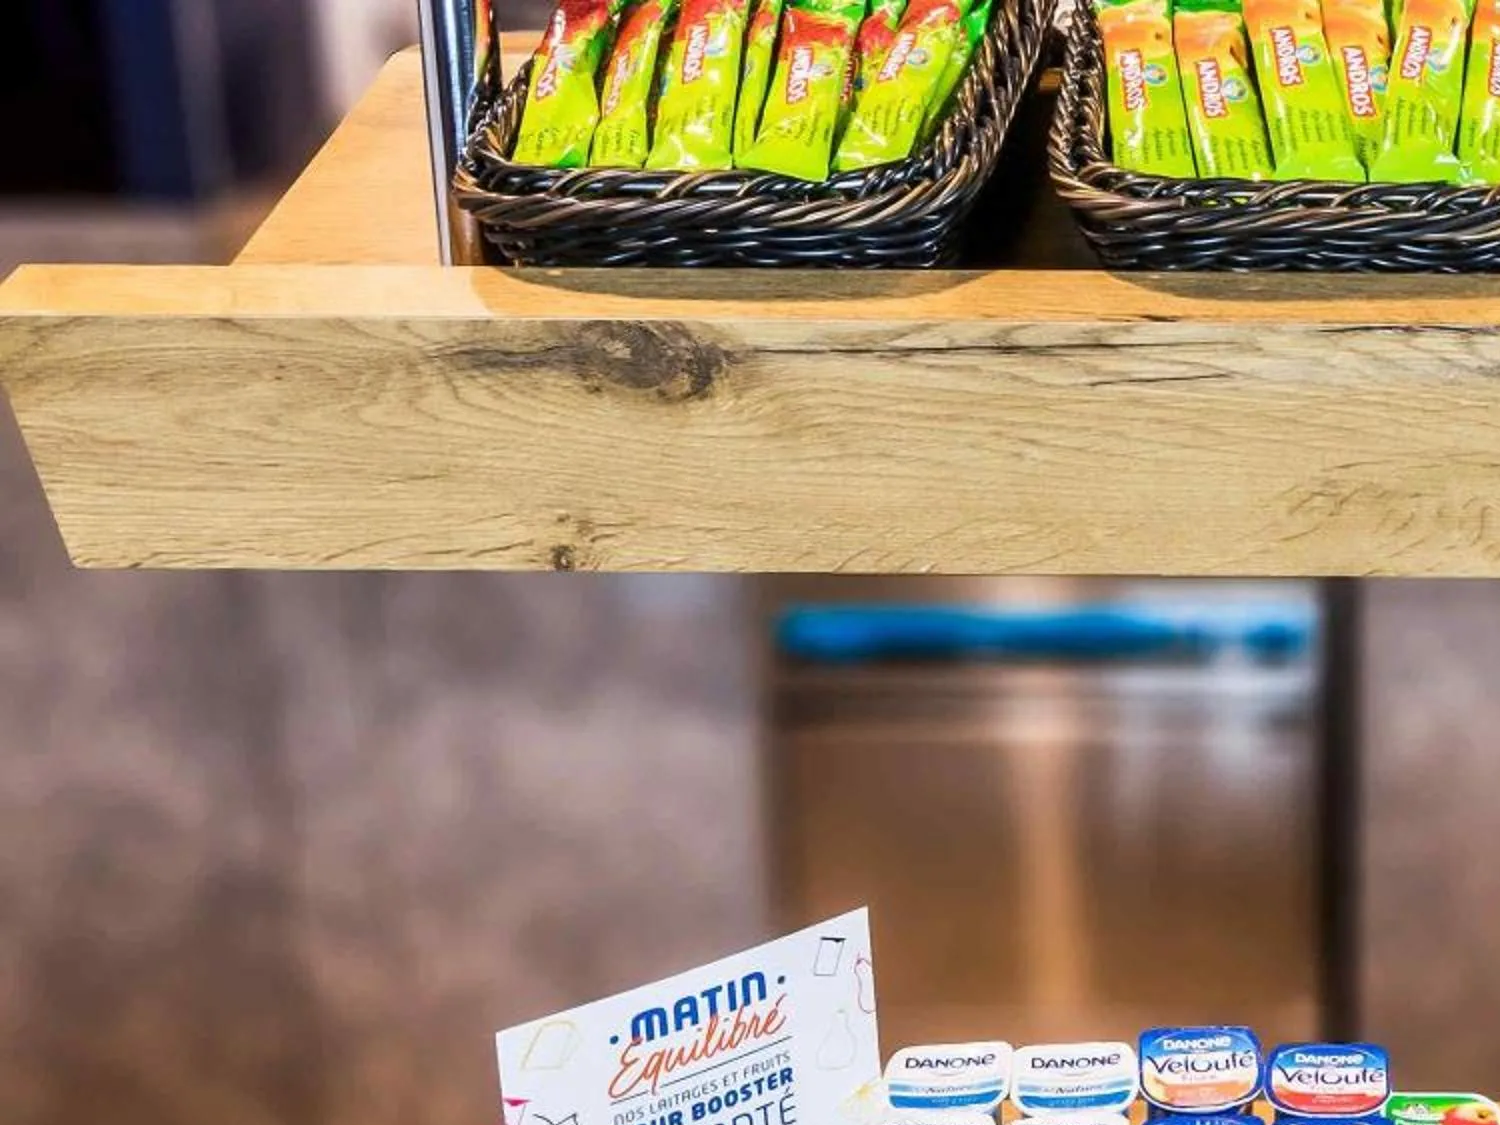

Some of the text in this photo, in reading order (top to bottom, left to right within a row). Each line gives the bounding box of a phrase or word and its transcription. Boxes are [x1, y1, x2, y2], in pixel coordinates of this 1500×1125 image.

[1272, 28, 1303, 87] ANDROS
[1199, 61, 1227, 118] ANDROS
[1344, 47, 1375, 117] ANDROS
[631, 971, 767, 1043] MATIN
[904, 1053, 996, 1070] DANONE
[1030, 1053, 1121, 1070] DANONE
[1146, 1050, 1254, 1074] Velouté
[1163, 1036, 1231, 1050] DANONE
[1295, 1053, 1364, 1065] DANONE
[649, 1080, 719, 1118] LAITAGES
[723, 1072, 739, 1087] ET
[743, 1053, 791, 1081] FRUITS
[691, 1067, 794, 1121] BOOSTER
[1276, 1064, 1384, 1085] Velouté
